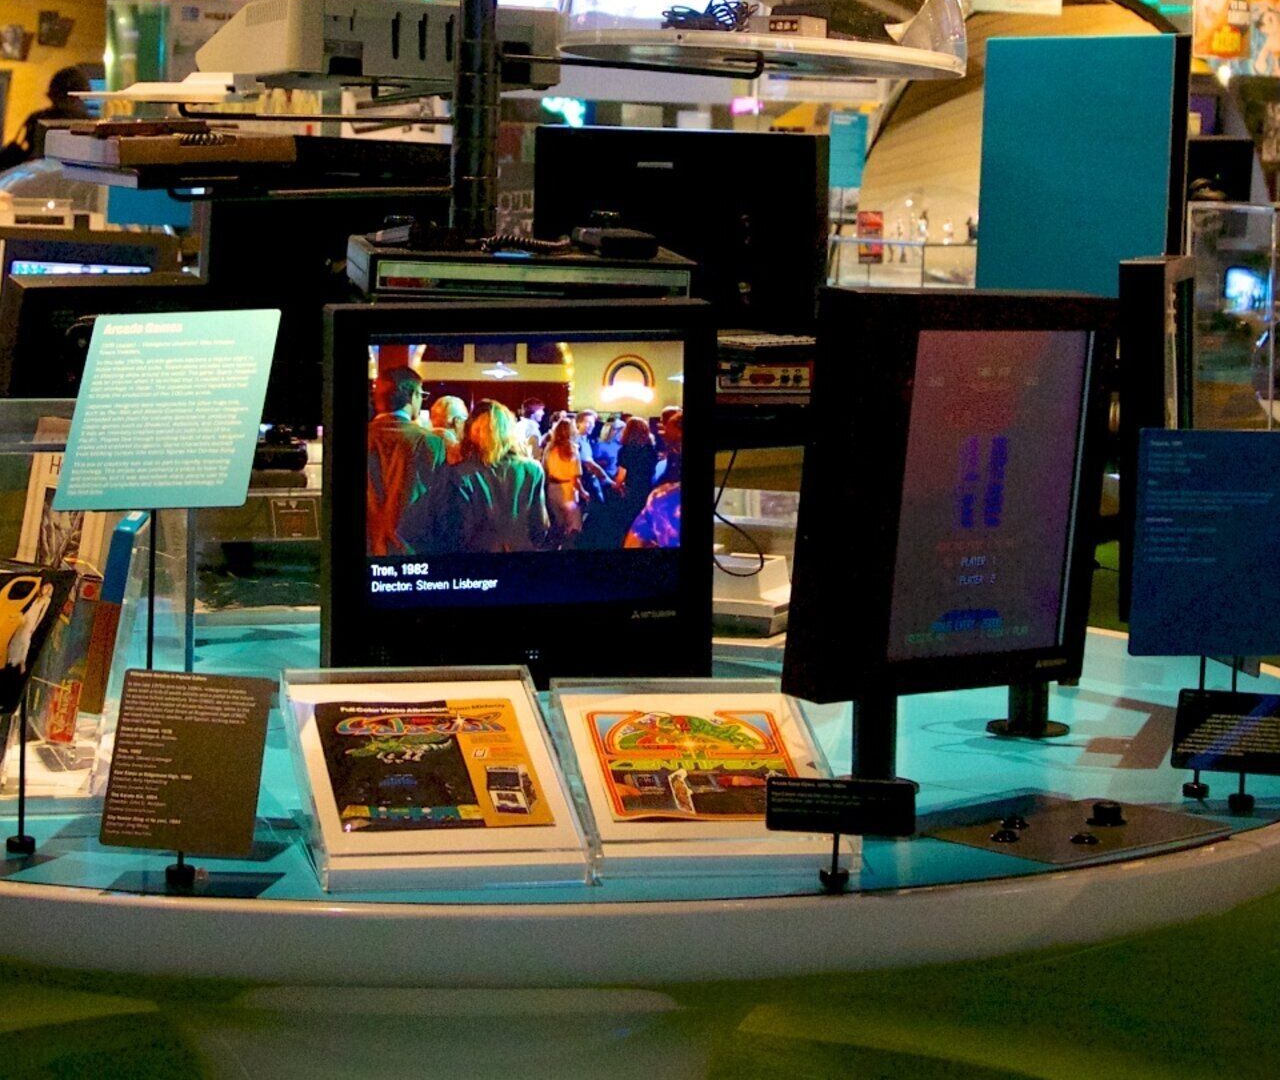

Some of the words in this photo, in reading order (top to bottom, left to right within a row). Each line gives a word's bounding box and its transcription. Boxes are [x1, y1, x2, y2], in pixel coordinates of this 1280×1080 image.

[103, 323, 144, 335] Arcade
[371, 564, 398, 577] Tron,
[401, 563, 429, 575] 1982
[371, 581, 413, 592] Director:
[416, 579, 450, 591] Steven
[452, 578, 498, 591] Lisberger
